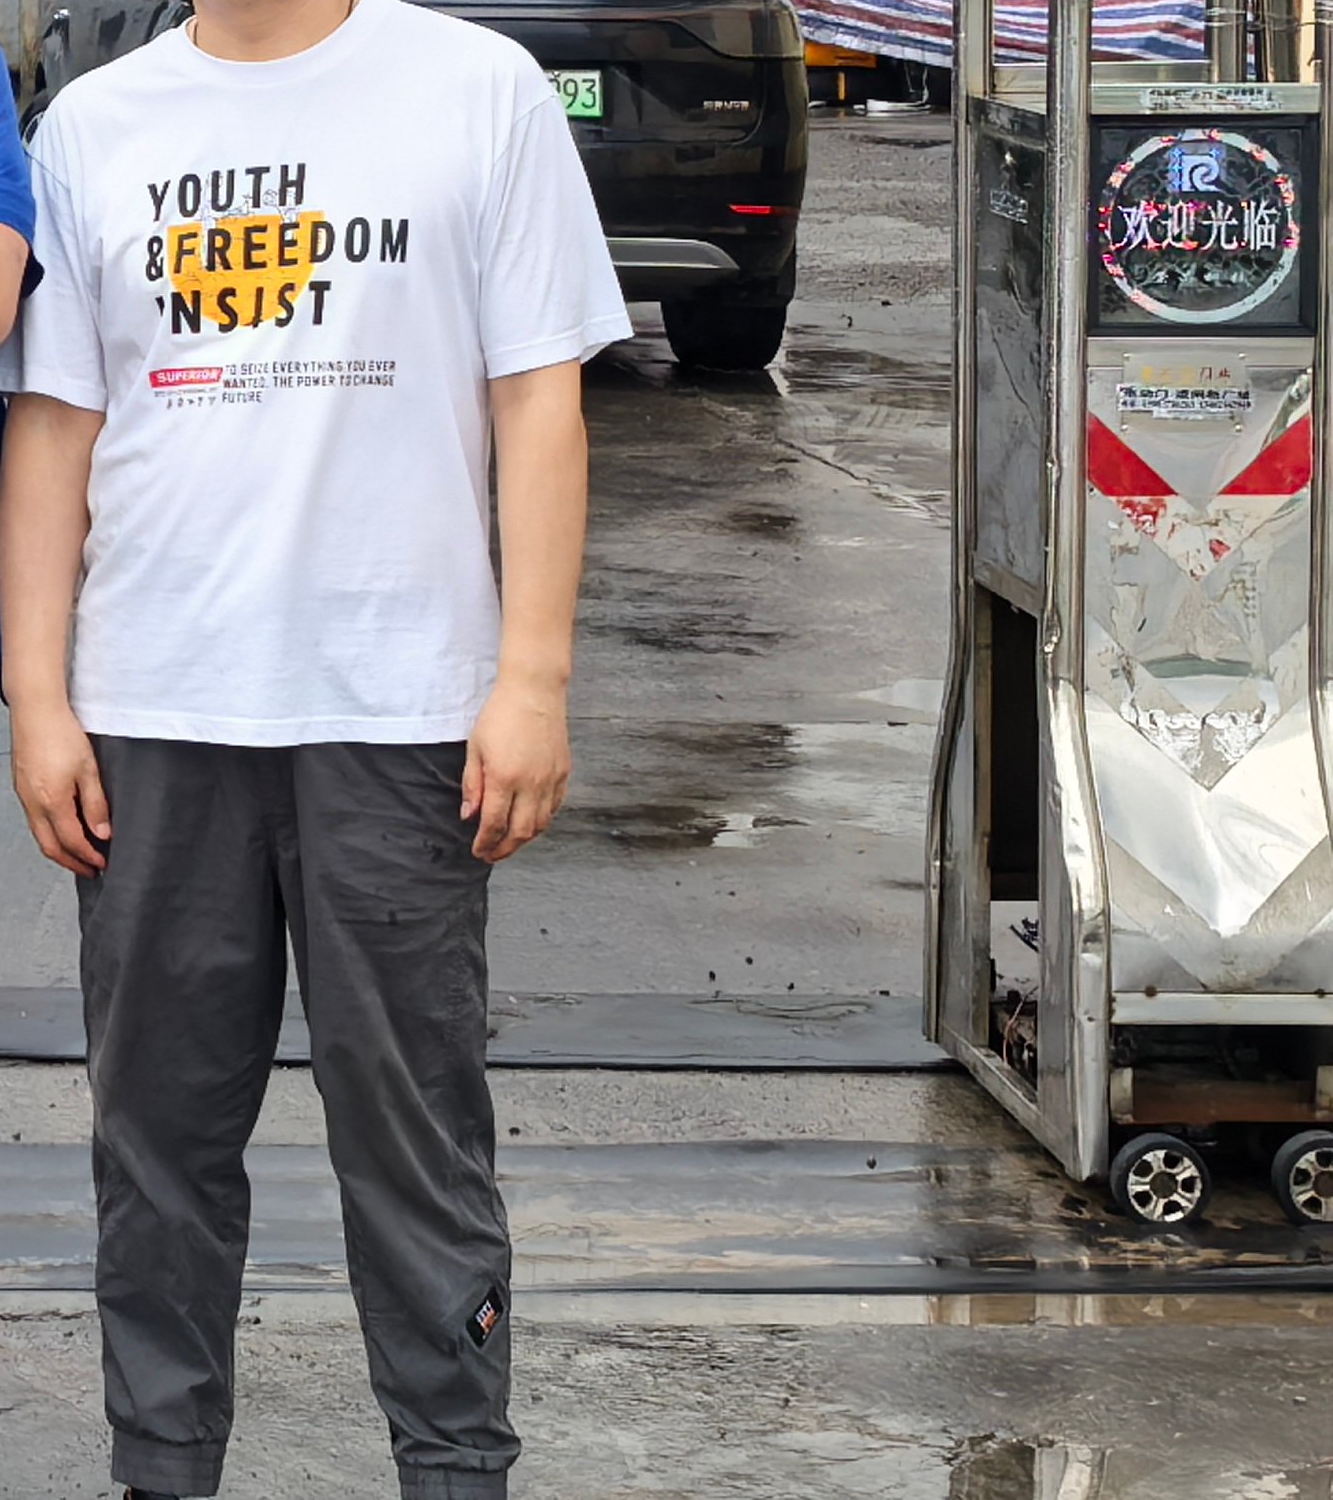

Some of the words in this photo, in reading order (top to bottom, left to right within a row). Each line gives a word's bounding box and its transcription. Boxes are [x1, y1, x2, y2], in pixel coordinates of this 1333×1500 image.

[147, 163, 306, 222] YOUTH
[1113, 198, 1279, 251] 欢迎光临
[273, 361, 344, 374] EVERYTHING
[346, 360, 366, 373] YOU
[368, 360, 397, 372] EVER
[273, 376, 295, 388] THE
[297, 376, 336, 388] POWER
